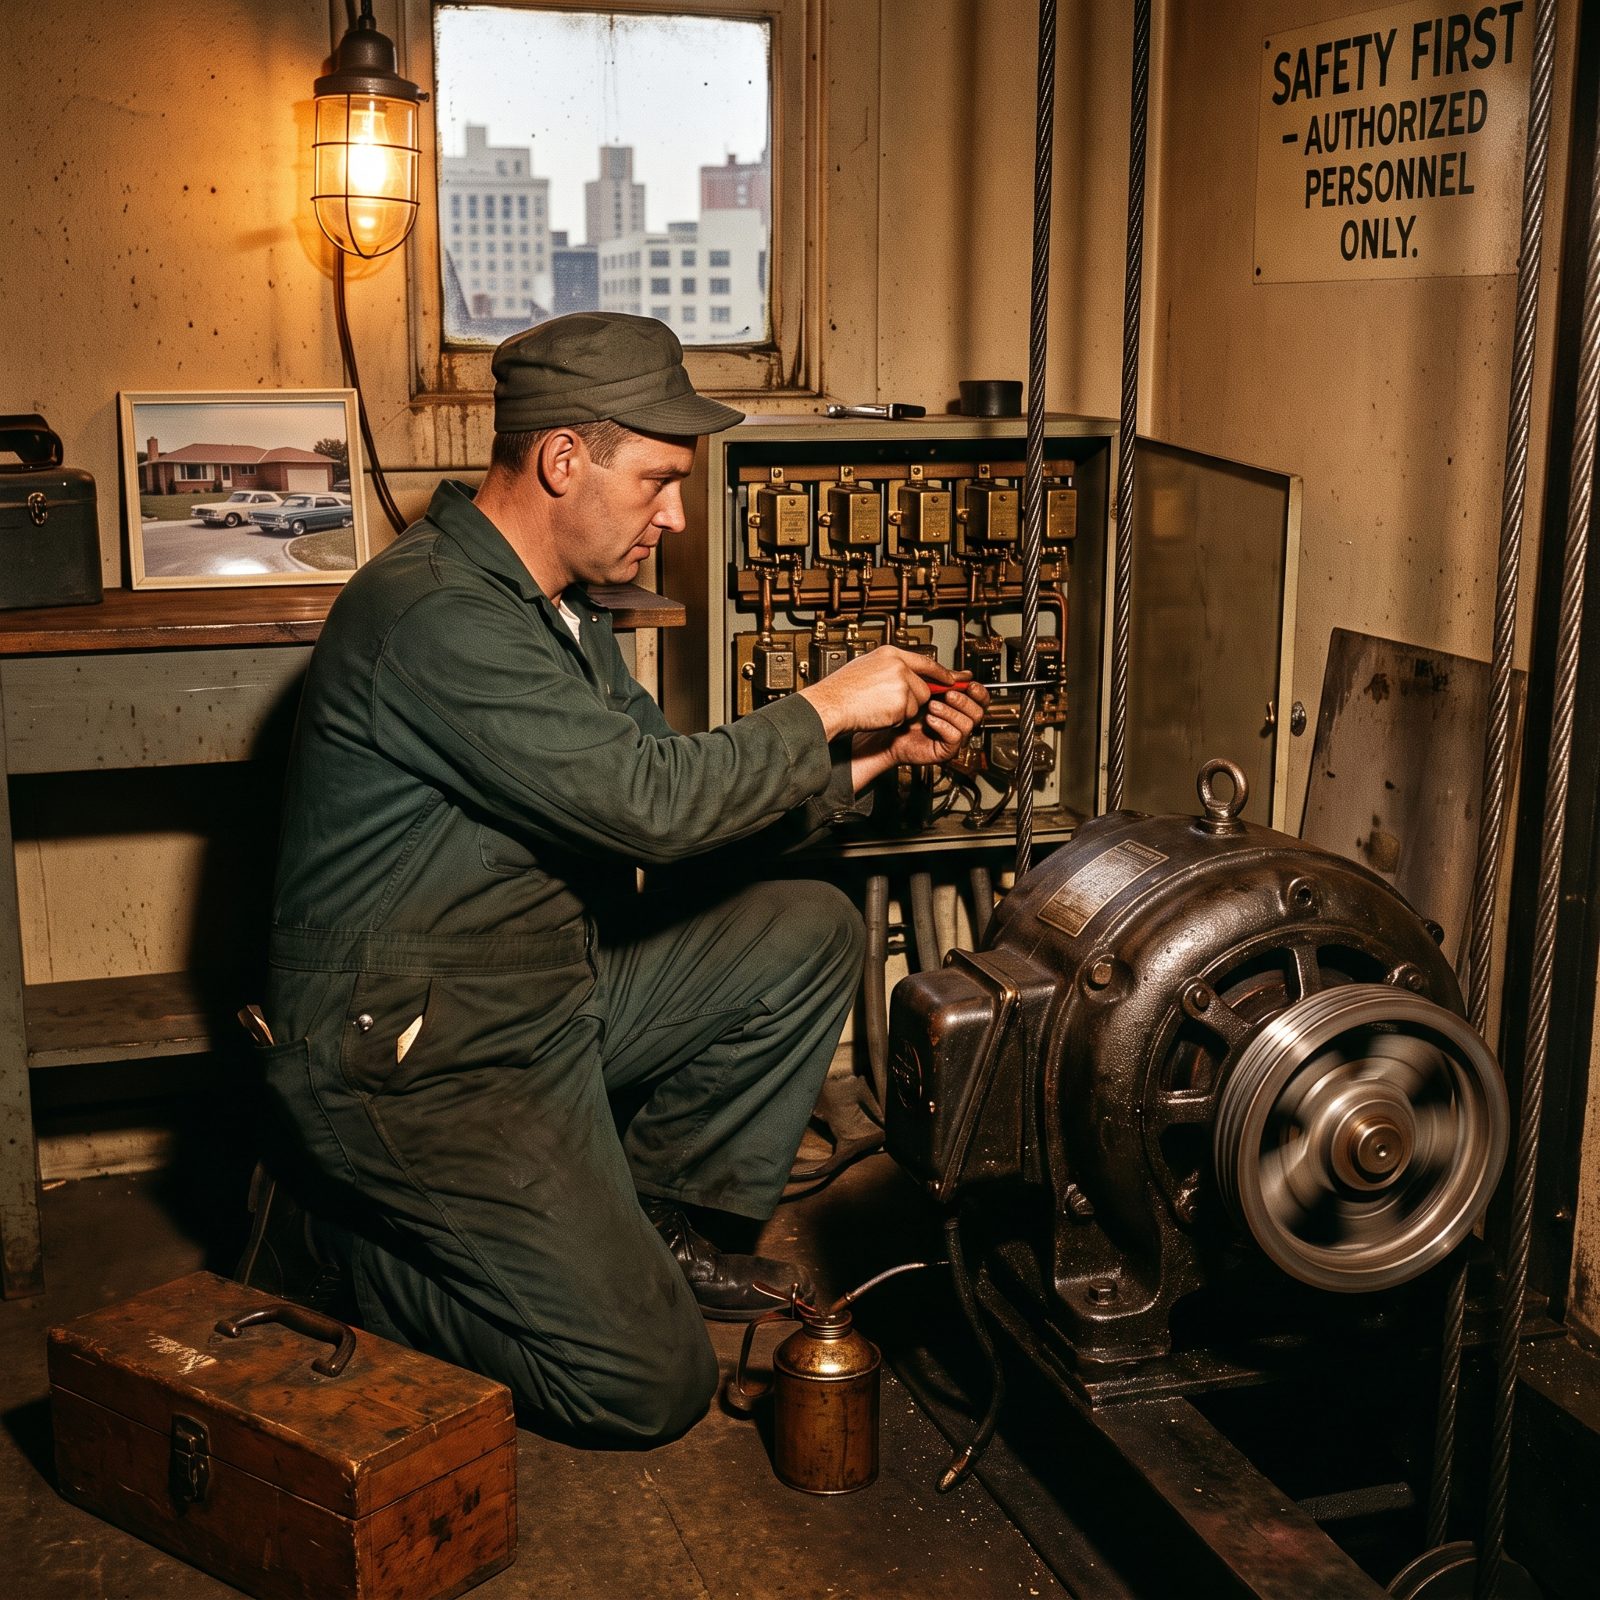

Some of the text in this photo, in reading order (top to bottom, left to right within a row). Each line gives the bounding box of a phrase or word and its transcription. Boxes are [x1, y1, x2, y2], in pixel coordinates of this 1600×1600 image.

[1272, 1, 1523, 105] SAFETY FIRST
[1305, 151, 1475, 209] PERSONNEL
[1340, 215, 1419, 261] ONLY.
